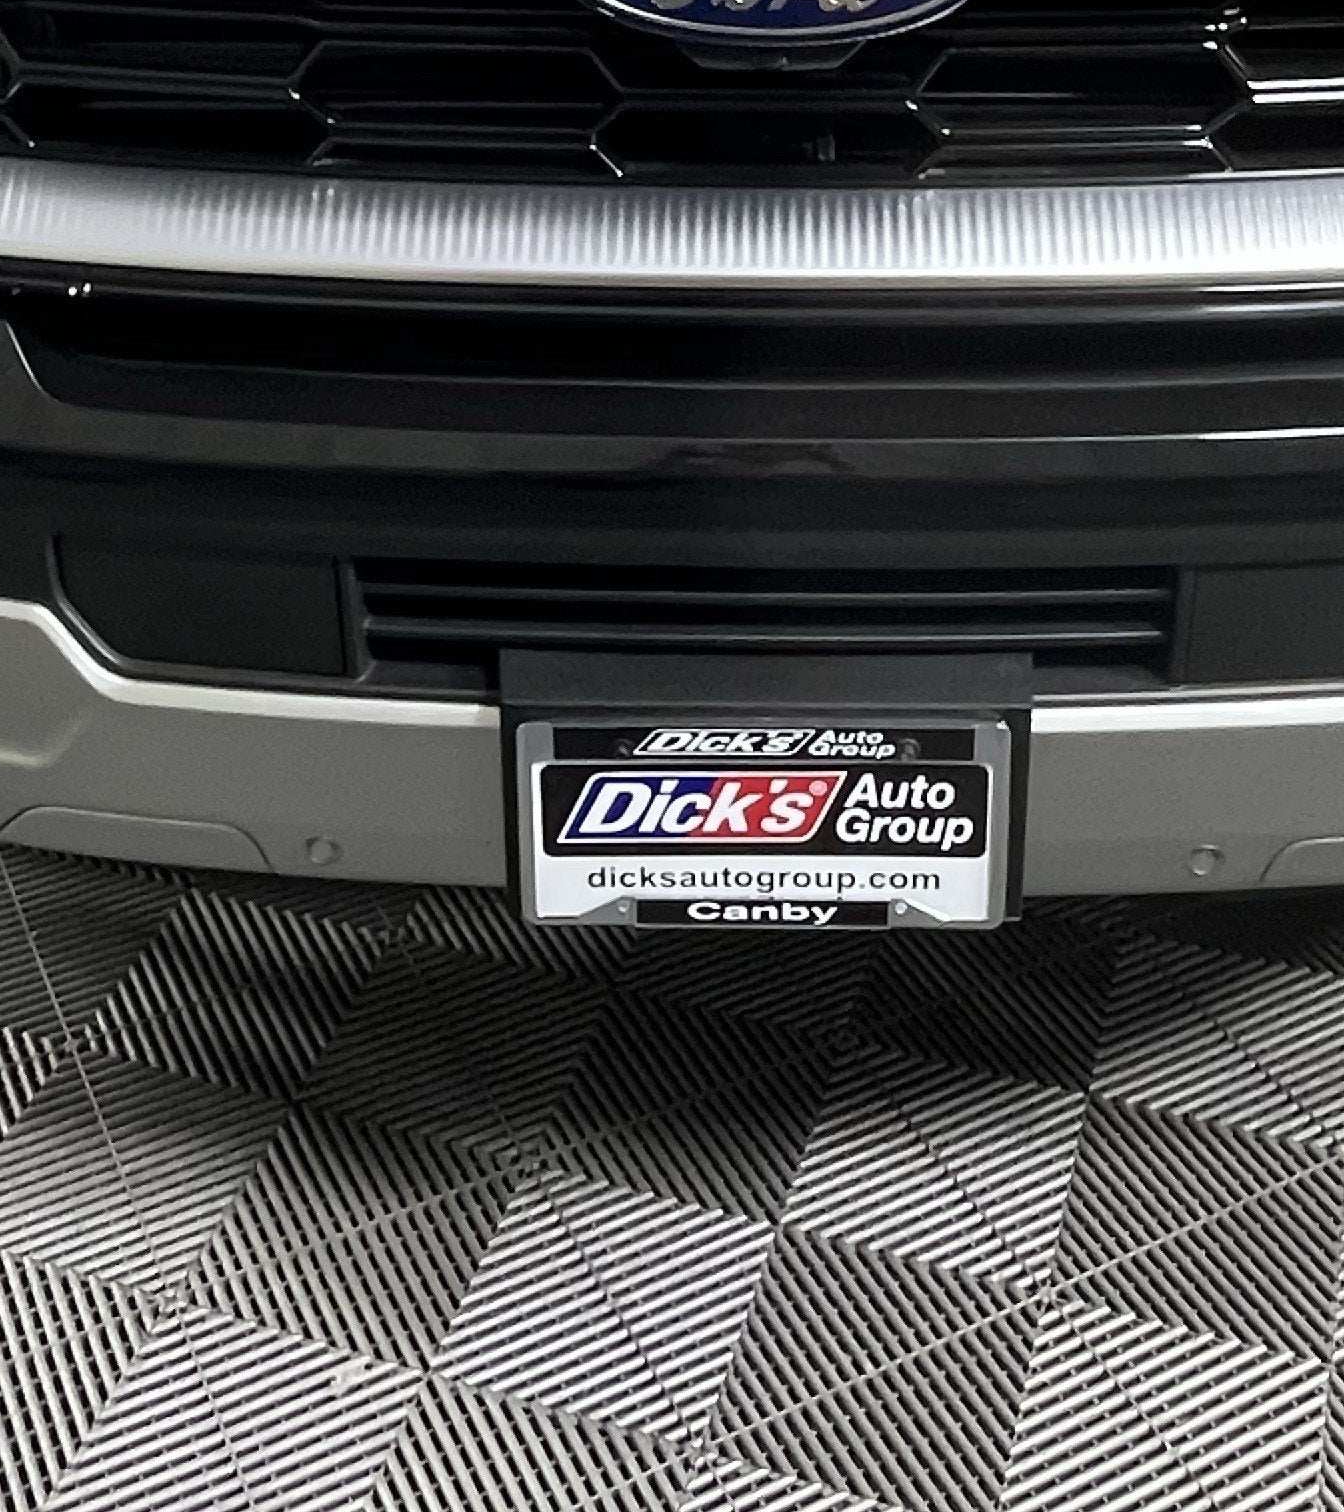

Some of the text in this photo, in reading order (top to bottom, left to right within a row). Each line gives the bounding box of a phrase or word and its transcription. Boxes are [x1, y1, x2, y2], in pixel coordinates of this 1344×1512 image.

[646, 731, 804, 752] Dick's
[819, 730, 884, 744] Auto
[808, 743, 896, 759] Group
[844, 772, 956, 809] Auto
[835, 808, 974, 852] Group
[587, 866, 941, 894] dicksautogroup.com
[686, 900, 838, 925] Canby
